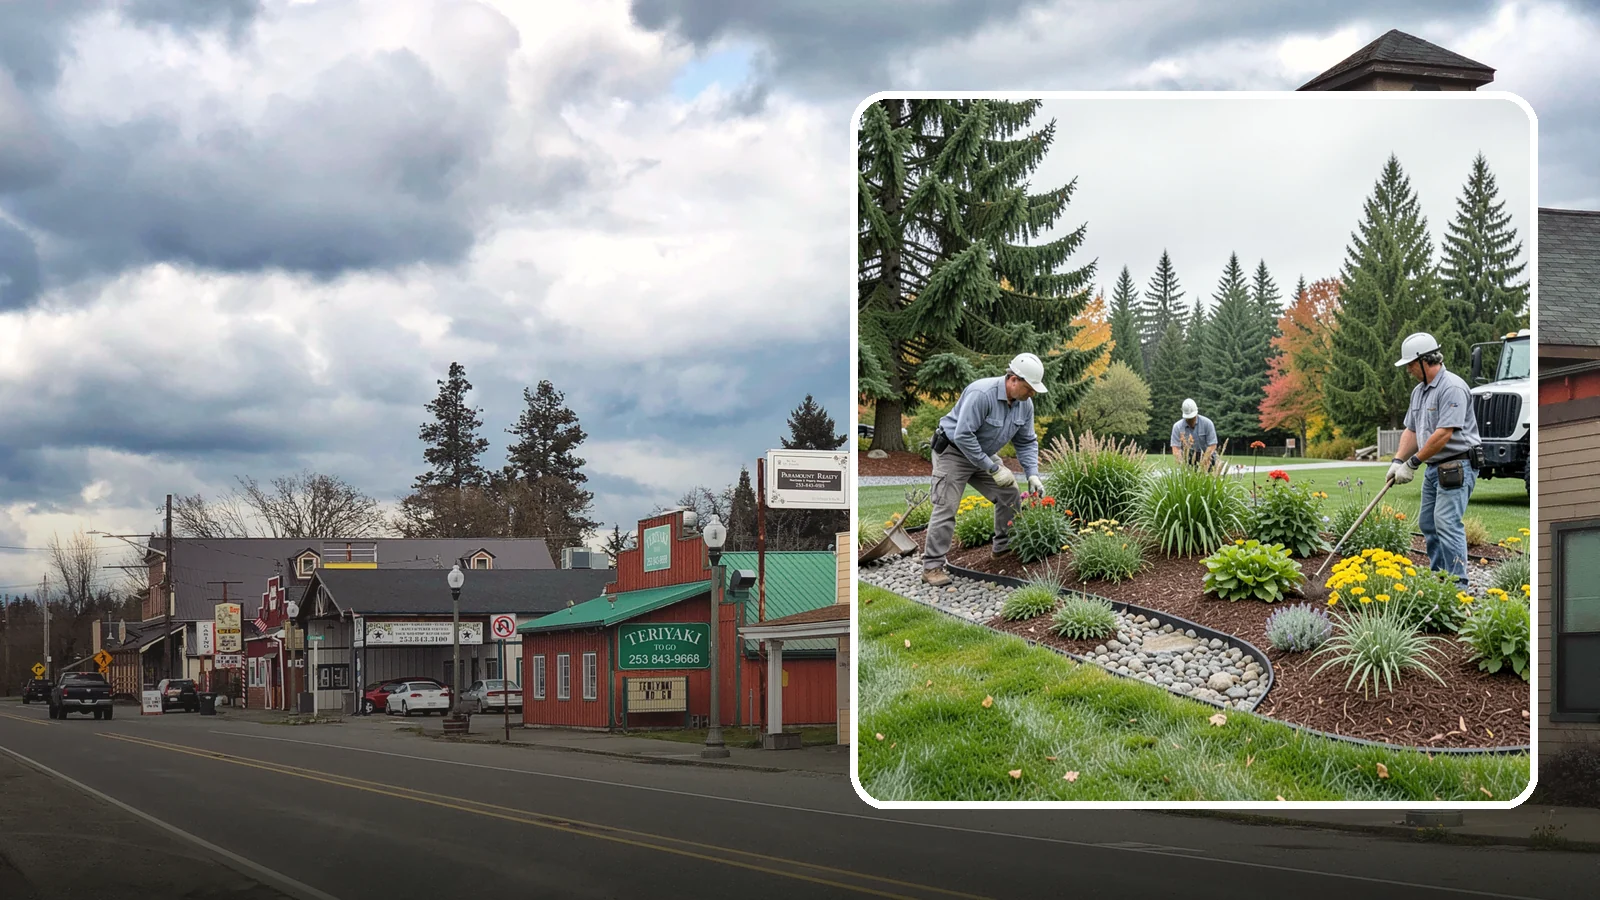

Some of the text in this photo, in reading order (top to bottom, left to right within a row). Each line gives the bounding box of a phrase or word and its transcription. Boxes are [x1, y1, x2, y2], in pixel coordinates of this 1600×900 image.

[781, 471, 839, 480] PARAMOUNT REALTY
[625, 627, 702, 646] TERIYAKI
[628, 654, 700, 665] 253 843-9668
